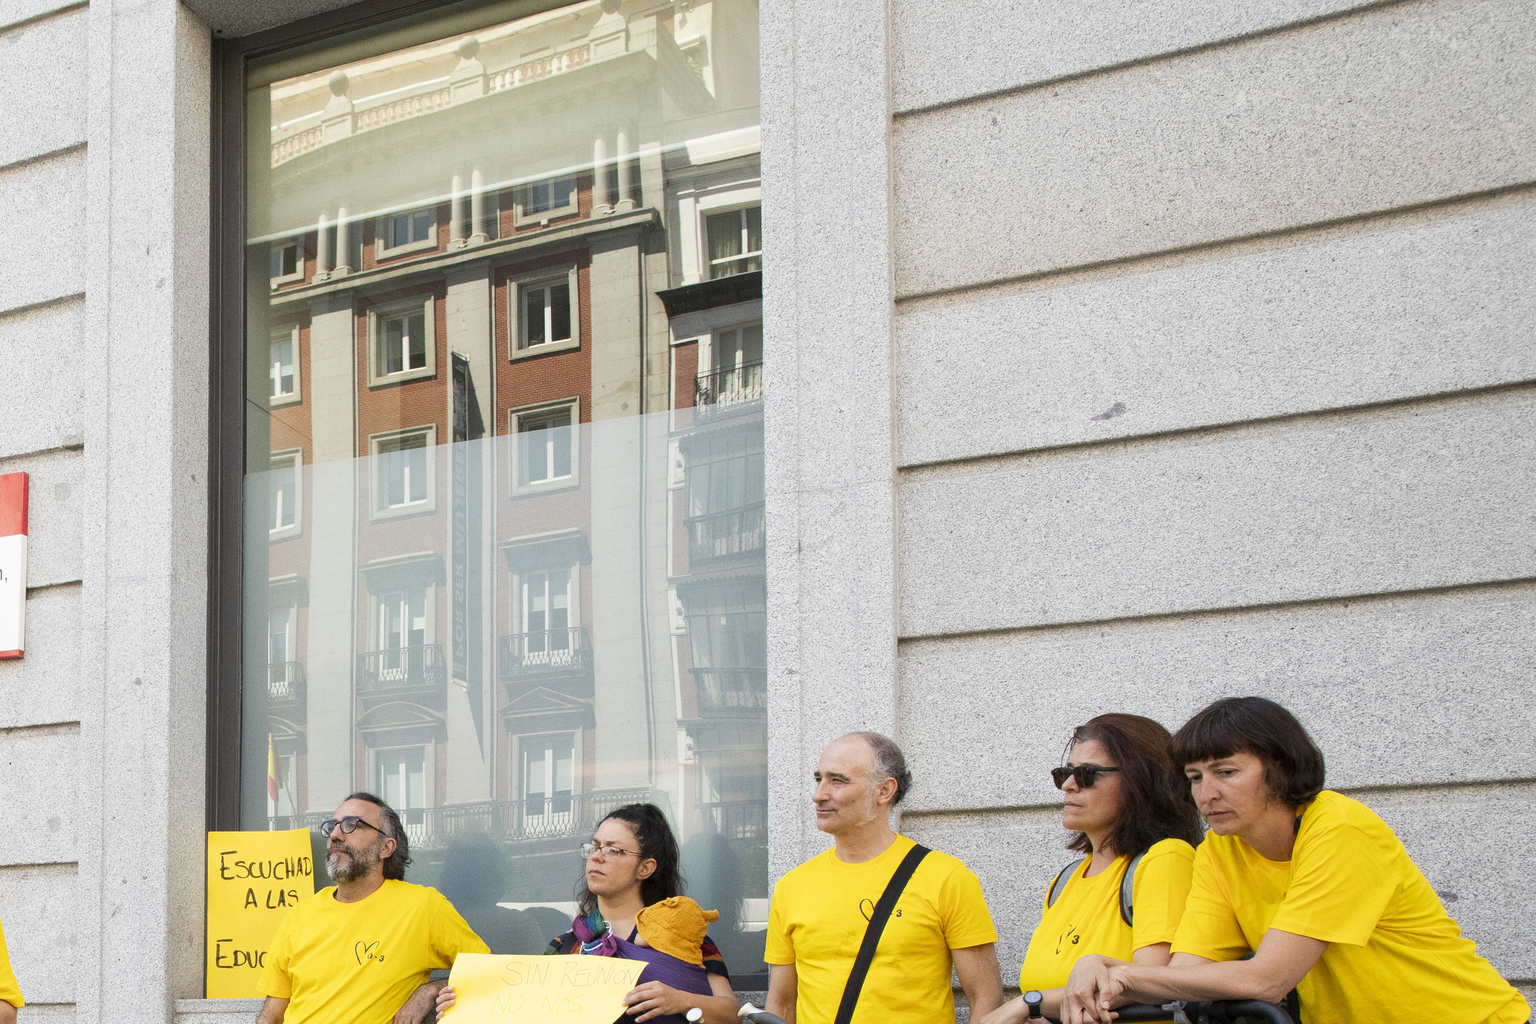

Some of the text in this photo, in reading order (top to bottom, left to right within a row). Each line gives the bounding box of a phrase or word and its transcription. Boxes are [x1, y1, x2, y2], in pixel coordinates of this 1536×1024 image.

[220, 851, 312, 880] ESCUCHAD
[244, 887, 299, 909] A LAS
[502, 961, 549, 987] SIN
[491, 994, 587, 1014] NO NOS
